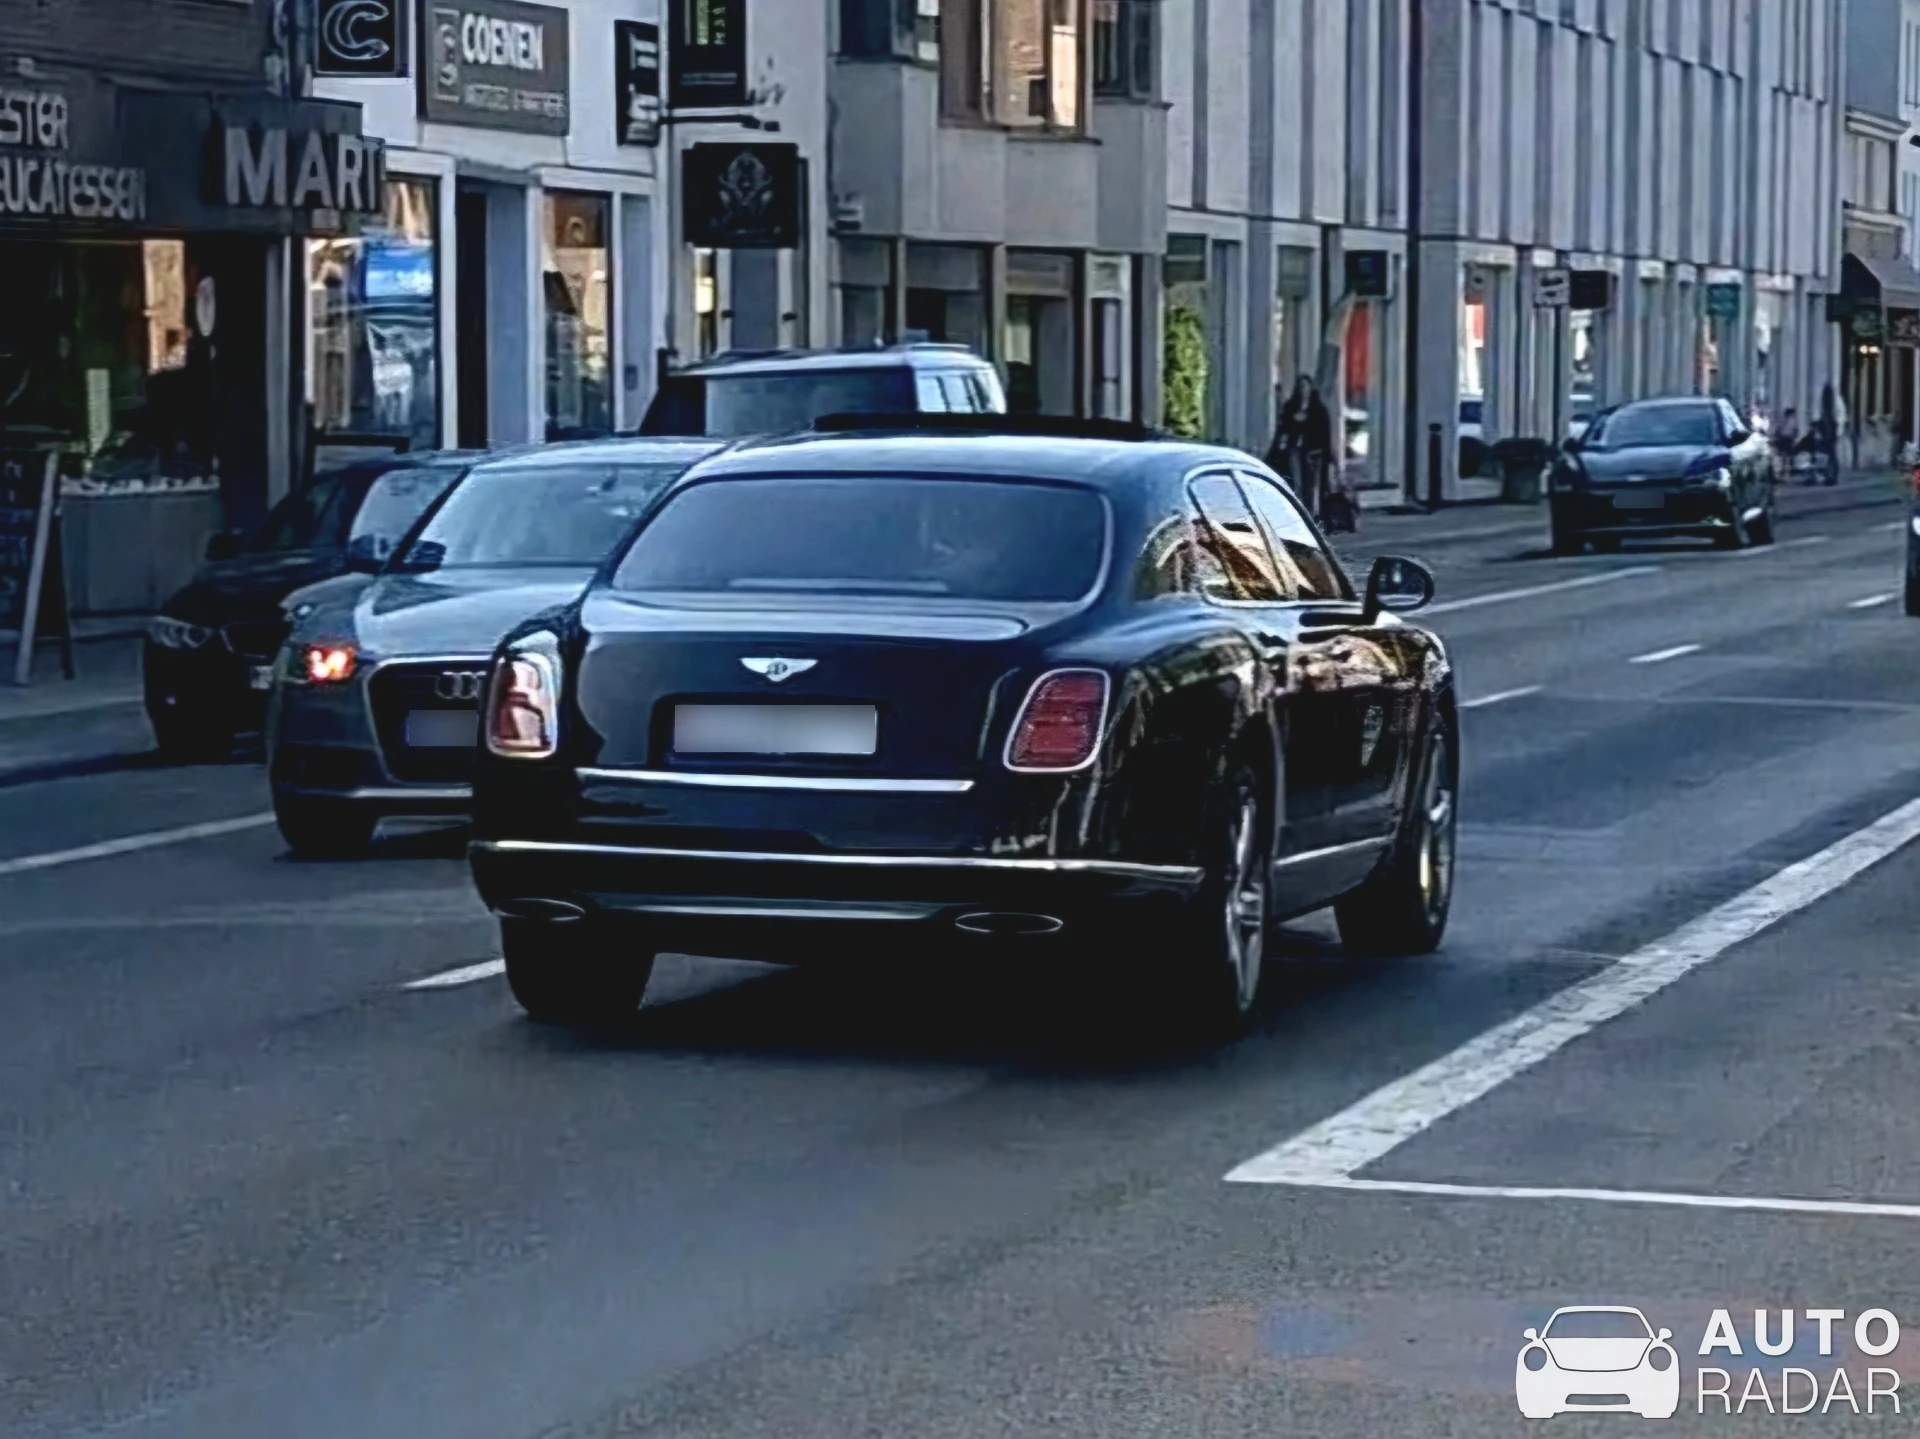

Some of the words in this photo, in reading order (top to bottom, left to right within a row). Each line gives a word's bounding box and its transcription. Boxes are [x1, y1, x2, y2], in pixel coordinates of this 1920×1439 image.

[462, 12, 544, 71] COENEN
[0, 156, 147, 220] LICATESSEN
[225, 126, 380, 211] MART
